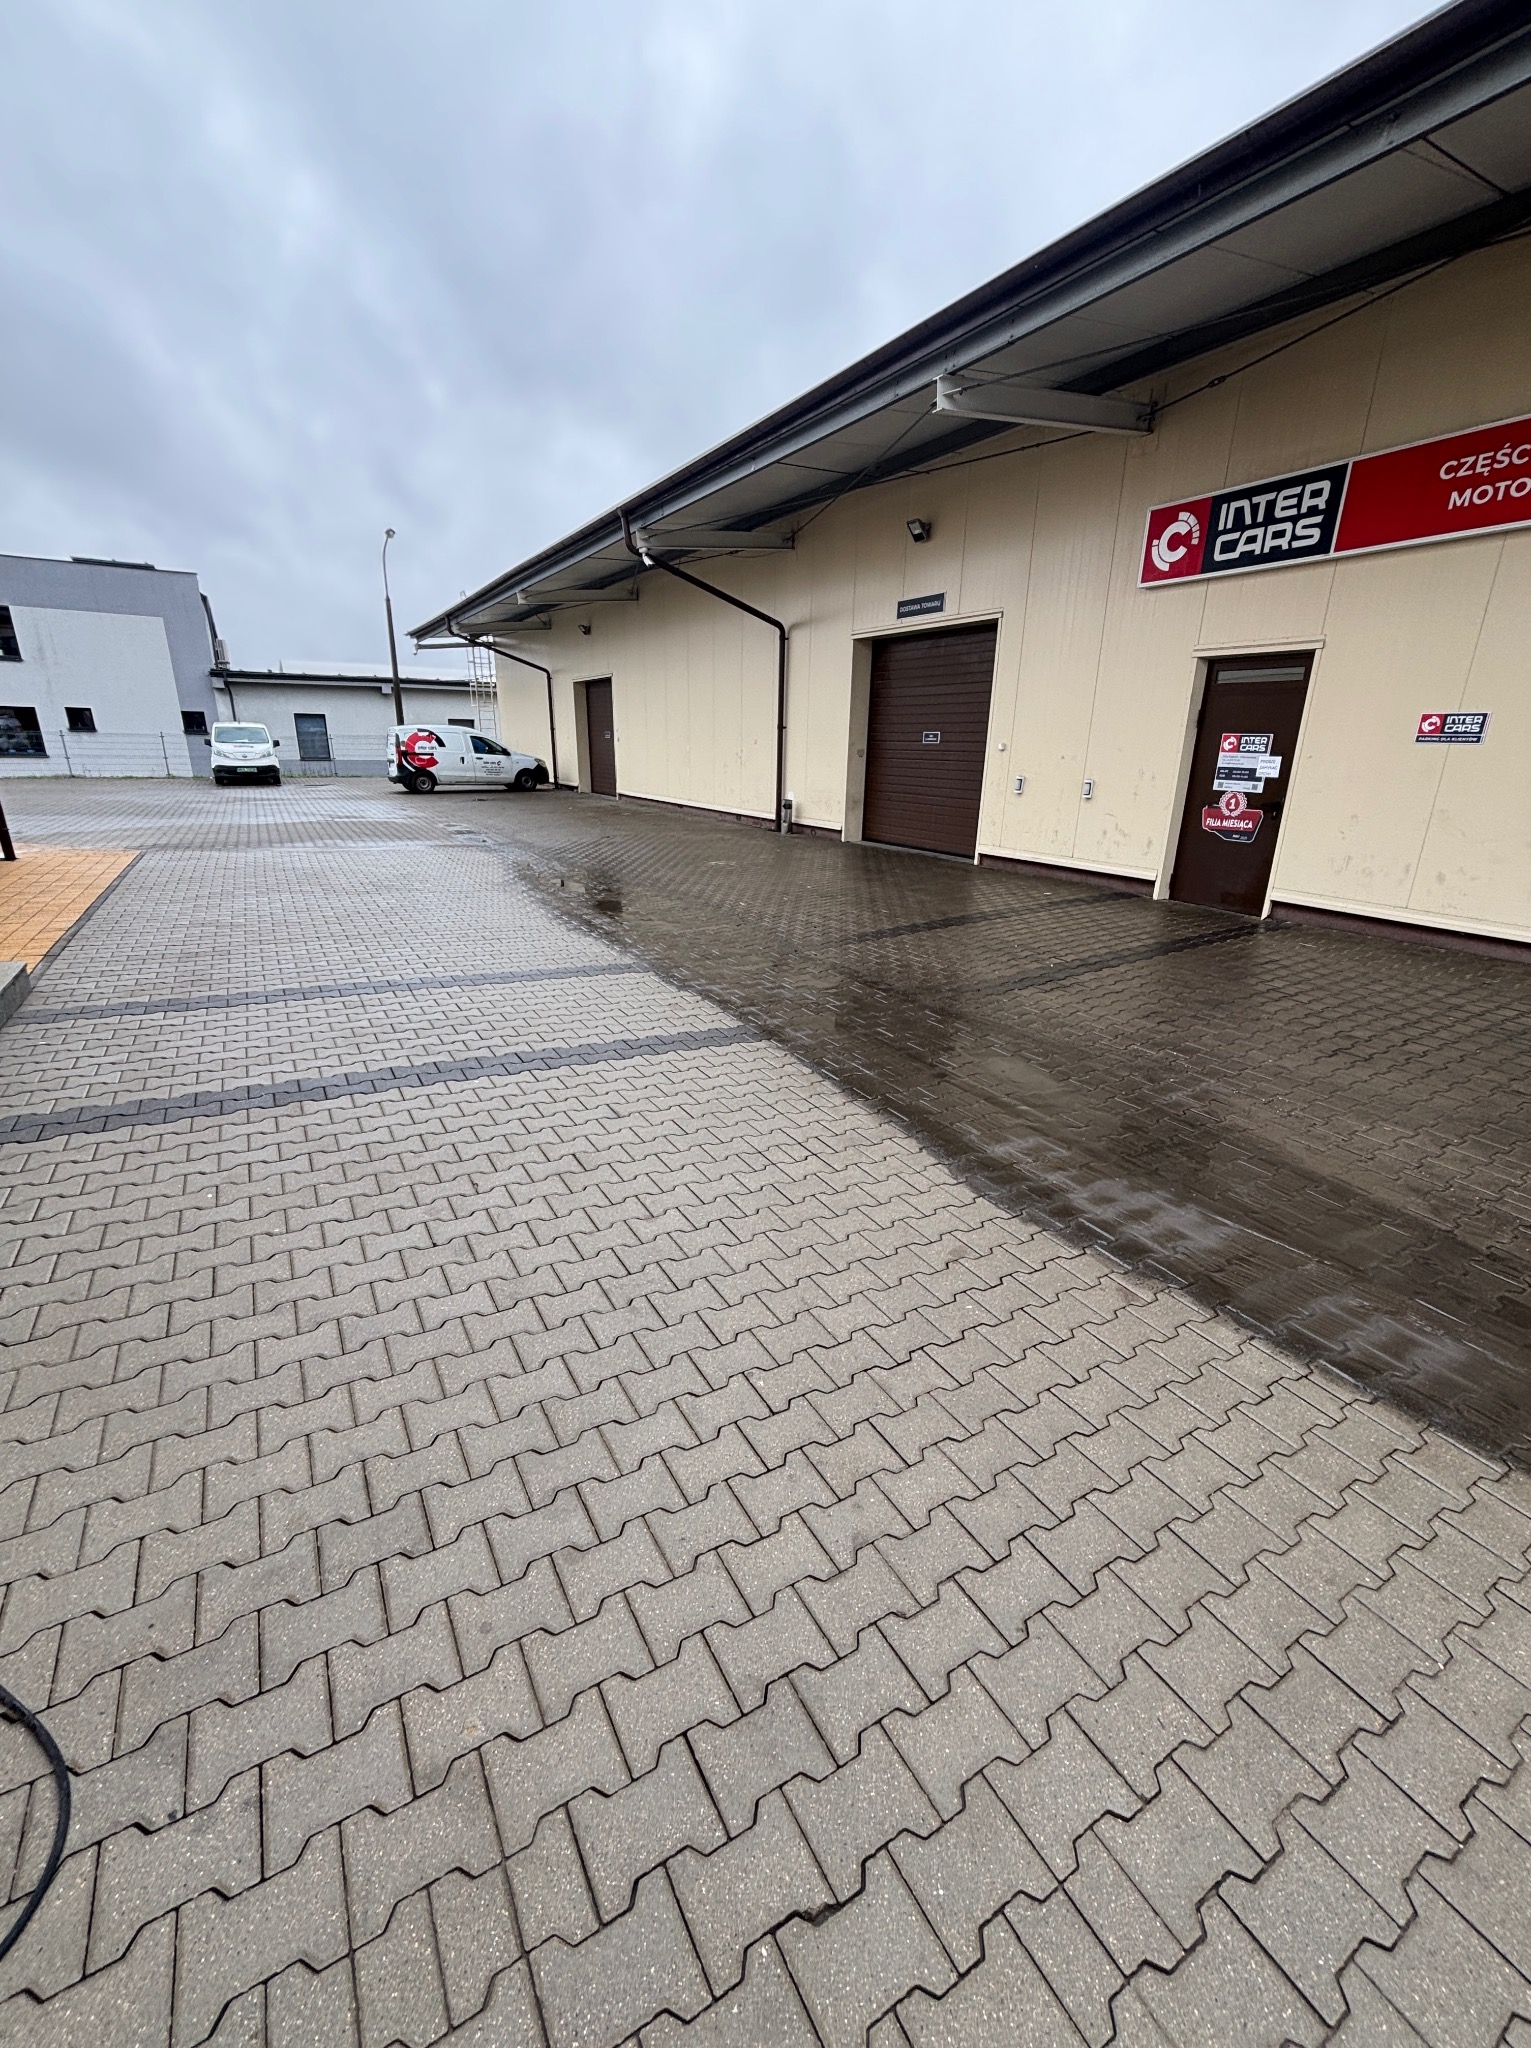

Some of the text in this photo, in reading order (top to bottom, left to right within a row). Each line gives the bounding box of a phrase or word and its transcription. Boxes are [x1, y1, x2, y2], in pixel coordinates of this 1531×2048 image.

[1440, 443, 1531, 480] CZĘŚC
[1448, 477, 1531, 510] MOTO
[1217, 479, 1332, 531] INTER
[1213, 514, 1325, 562] CARS
[899, 600, 941, 613] DOSTAWA TOWARU
[1446, 715, 1484, 724] INTER
[1443, 724, 1481, 733] CARS
[1240, 736, 1268, 745] INTER
[1239, 744, 1266, 752] CARS
[1228, 798, 1236, 809] 1
[1205, 817, 1253, 831] FILIA MIESIĄCA
